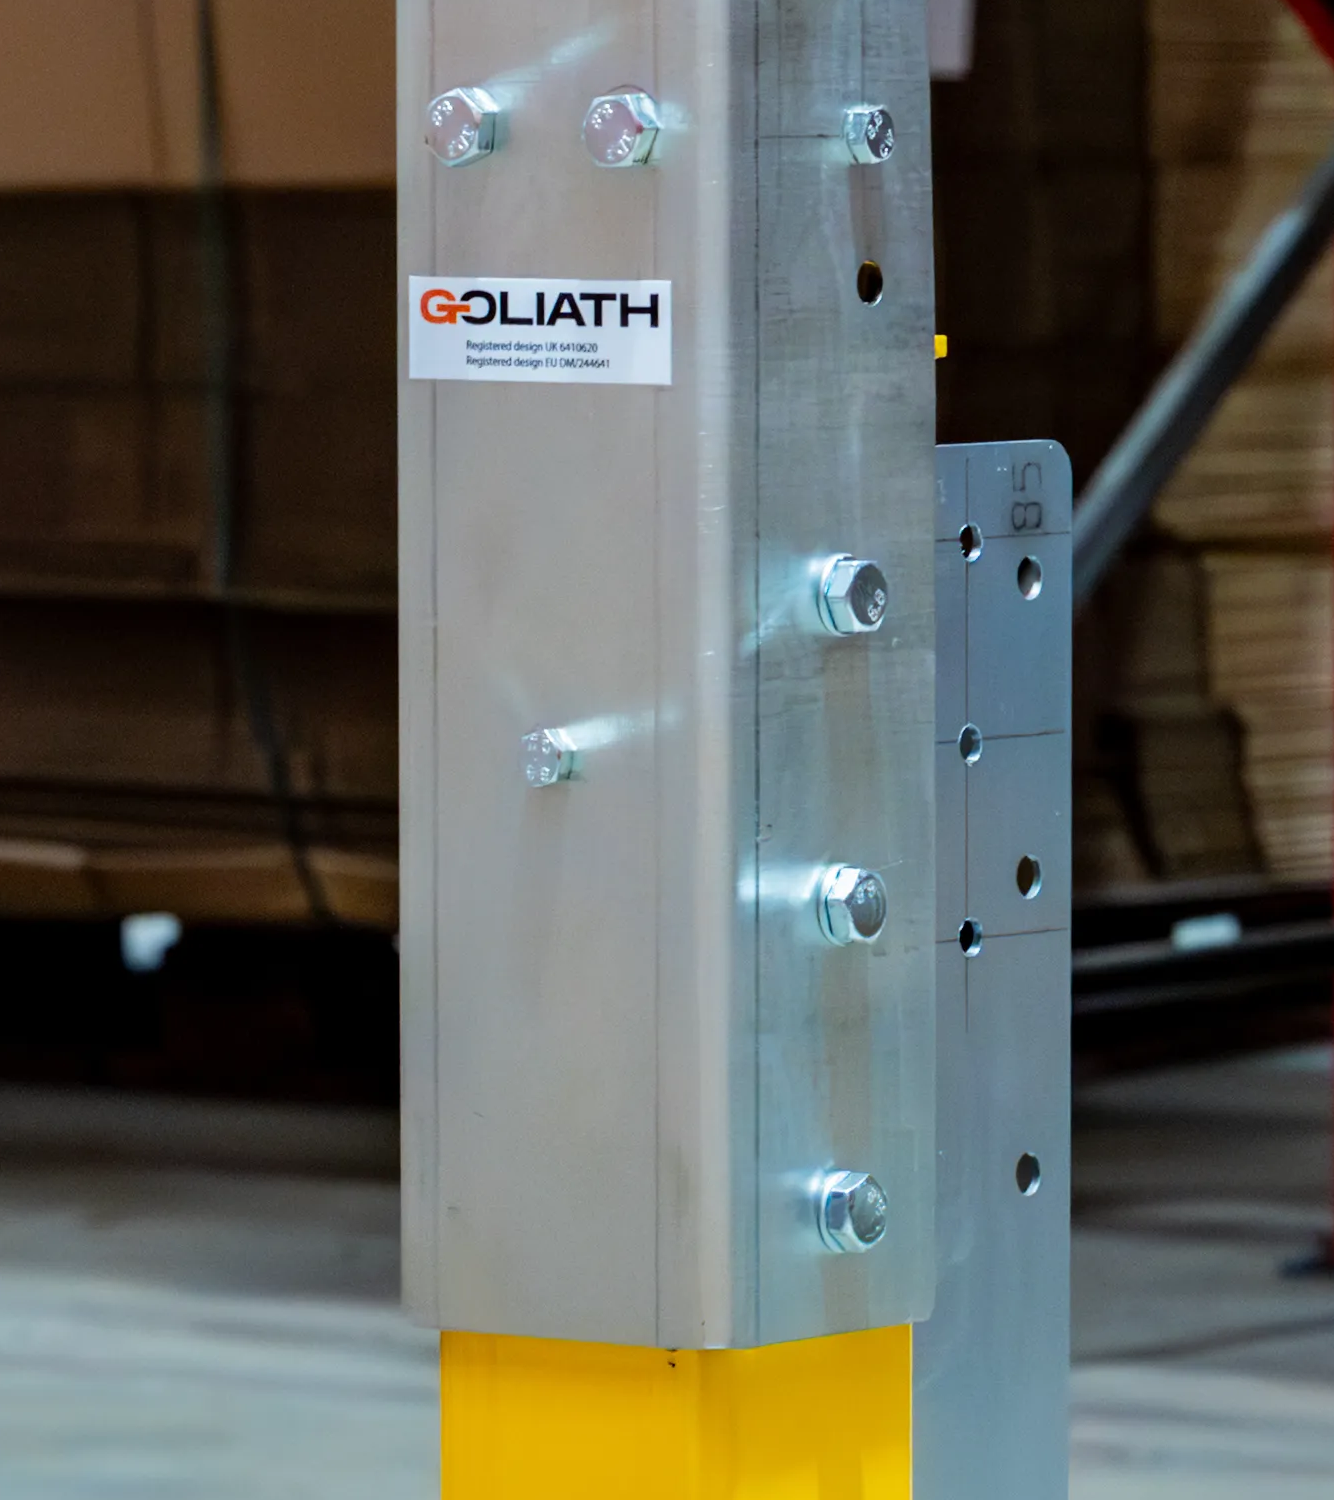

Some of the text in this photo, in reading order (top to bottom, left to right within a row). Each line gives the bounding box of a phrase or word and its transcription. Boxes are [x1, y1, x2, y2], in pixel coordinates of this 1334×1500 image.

[420, 288, 659, 328] GOLIATH
[466, 340, 512, 354] Registered
[514, 341, 543, 354] design
[545, 342, 558, 352] UK
[466, 355, 512, 369] Registered
[514, 357, 543, 369] design
